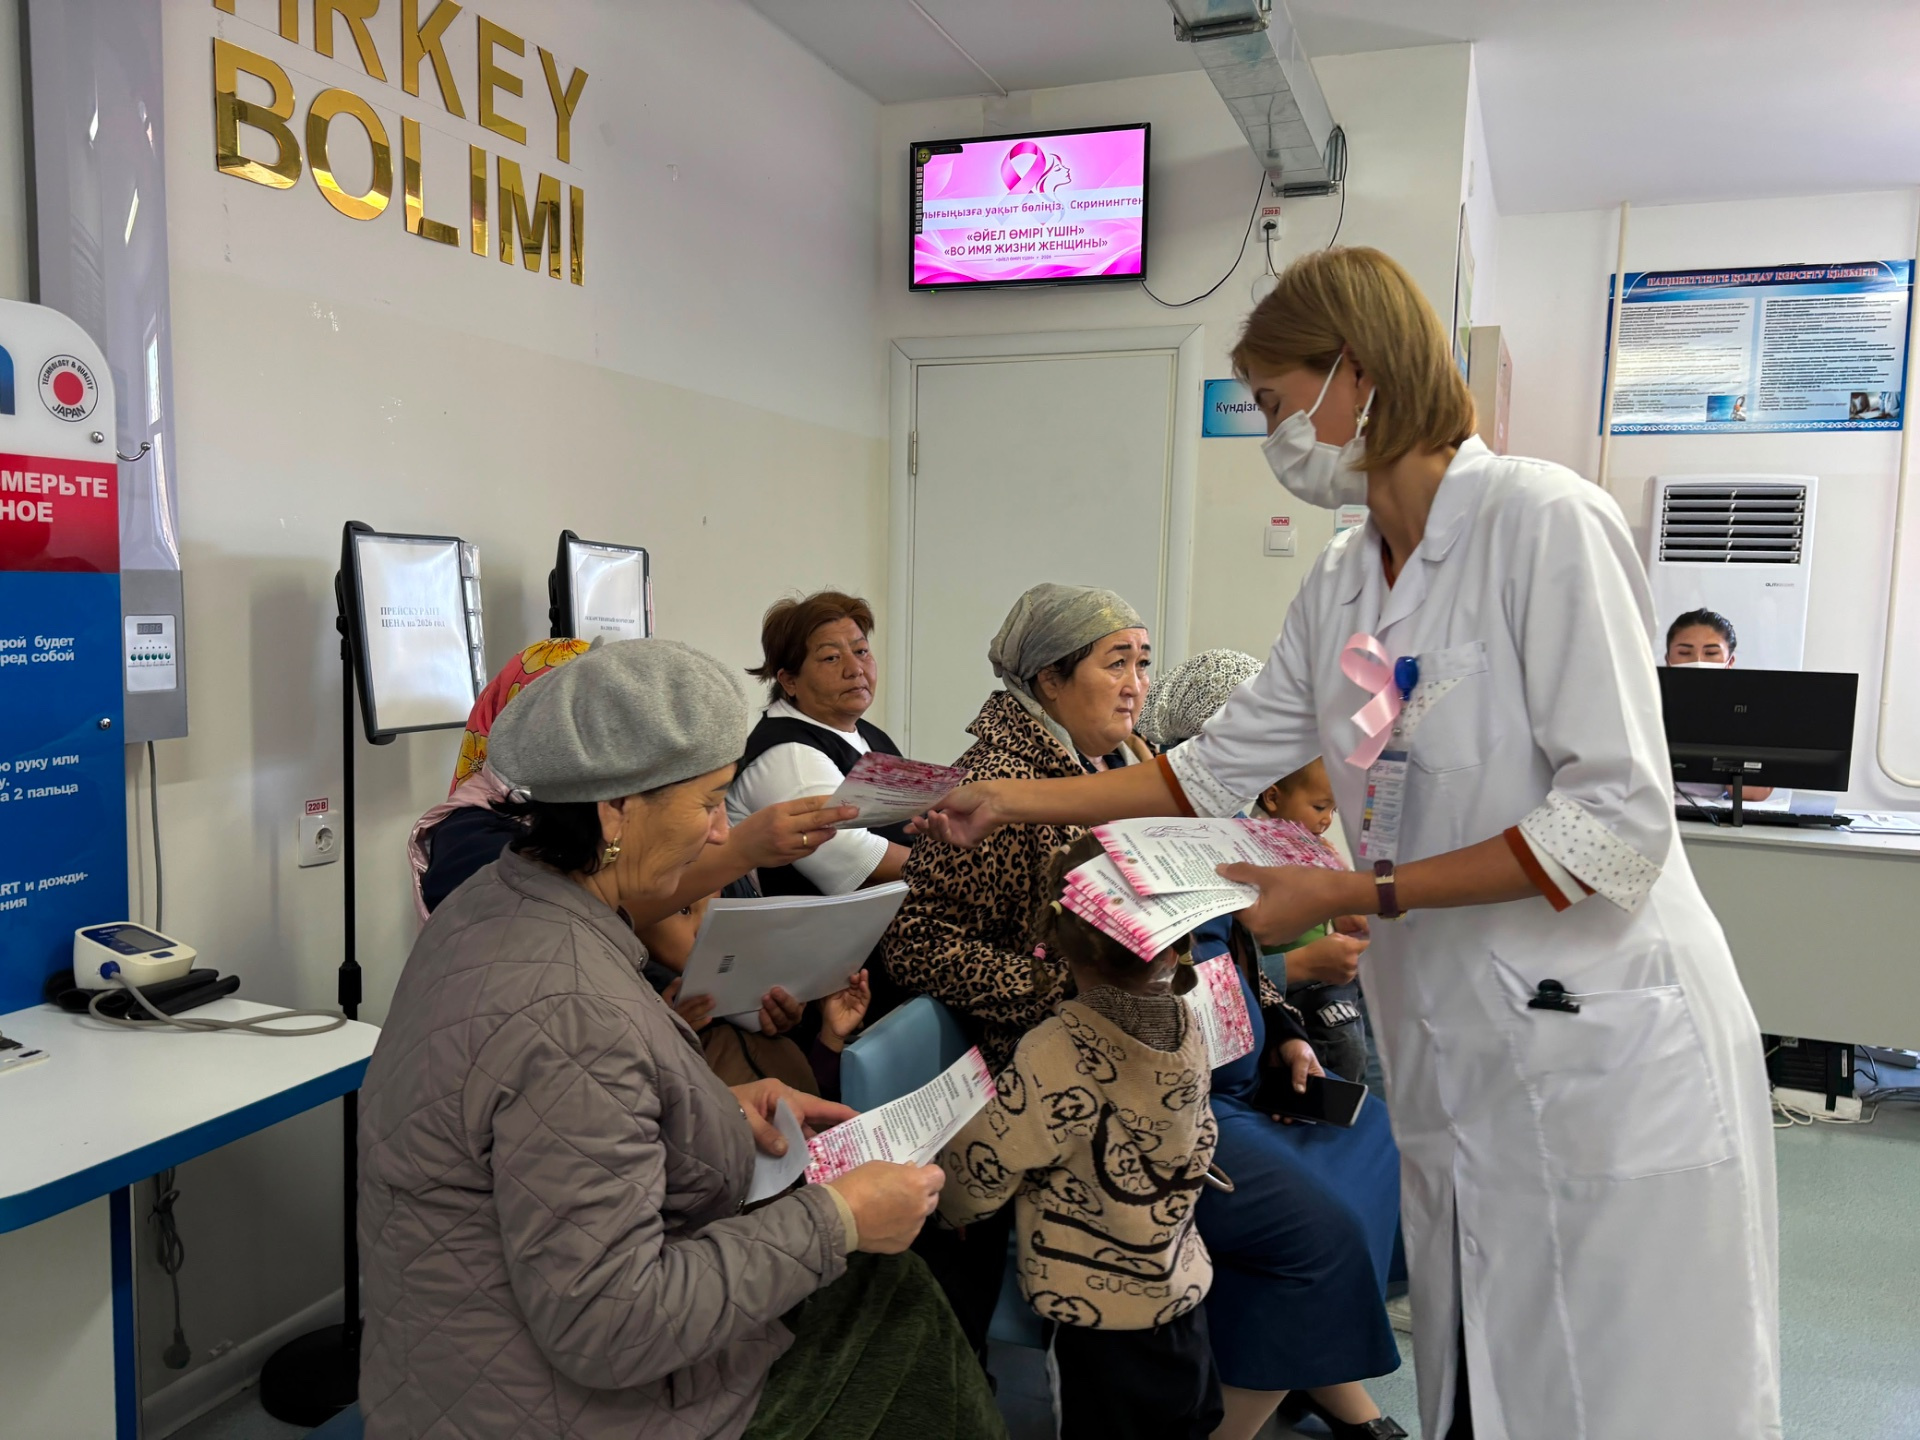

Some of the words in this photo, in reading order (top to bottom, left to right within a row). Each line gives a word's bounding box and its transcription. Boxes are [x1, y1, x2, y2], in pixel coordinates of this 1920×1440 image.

[215, 0, 588, 163] RKEY
[213, 37, 584, 286] BOLIMI
[985, 204, 1020, 217] уақыт
[1021, 201, 1064, 213] бөліңіз.
[967, 228, 1005, 242] «ӘЙЕЛ
[1008, 227, 1042, 240] ӨМІРІ
[1046, 225, 1085, 237] ҮШІН»
[944, 245, 965, 256] «ВО
[967, 244, 992, 255] ИМЯ
[994, 241, 1036, 254] ЖИЗНИ
[1038, 238, 1108, 251] ЖЕНЩИНЫ»
[42, 359, 69, 386] TECHNOLOGY
[77, 365, 94, 390] QUALITY
[52, 404, 86, 419] JAPAN
[1216, 401, 1261, 415] Күндізг
[1, 470, 109, 498] МЕРЬТЕ
[380, 606, 440, 616] ПРЕЙСКУРАНТ
[381, 618, 406, 628] ЦЕНА
[34, 635, 75, 651] будет
[0, 653, 28, 667] ред
[31, 649, 75, 663] собой
[15, 757, 49, 774] руку
[52, 754, 80, 767] или
[14, 786, 24, 801] 2
[27, 783, 79, 799] пальца
[308, 802, 320, 812] 220
[0, 881, 21, 897] RT
[25, 881, 35, 892] и
[38, 872, 89, 891] дожди-
[0, 897, 28, 912] ния
[1085, 1274, 1172, 1299] GUCCI
